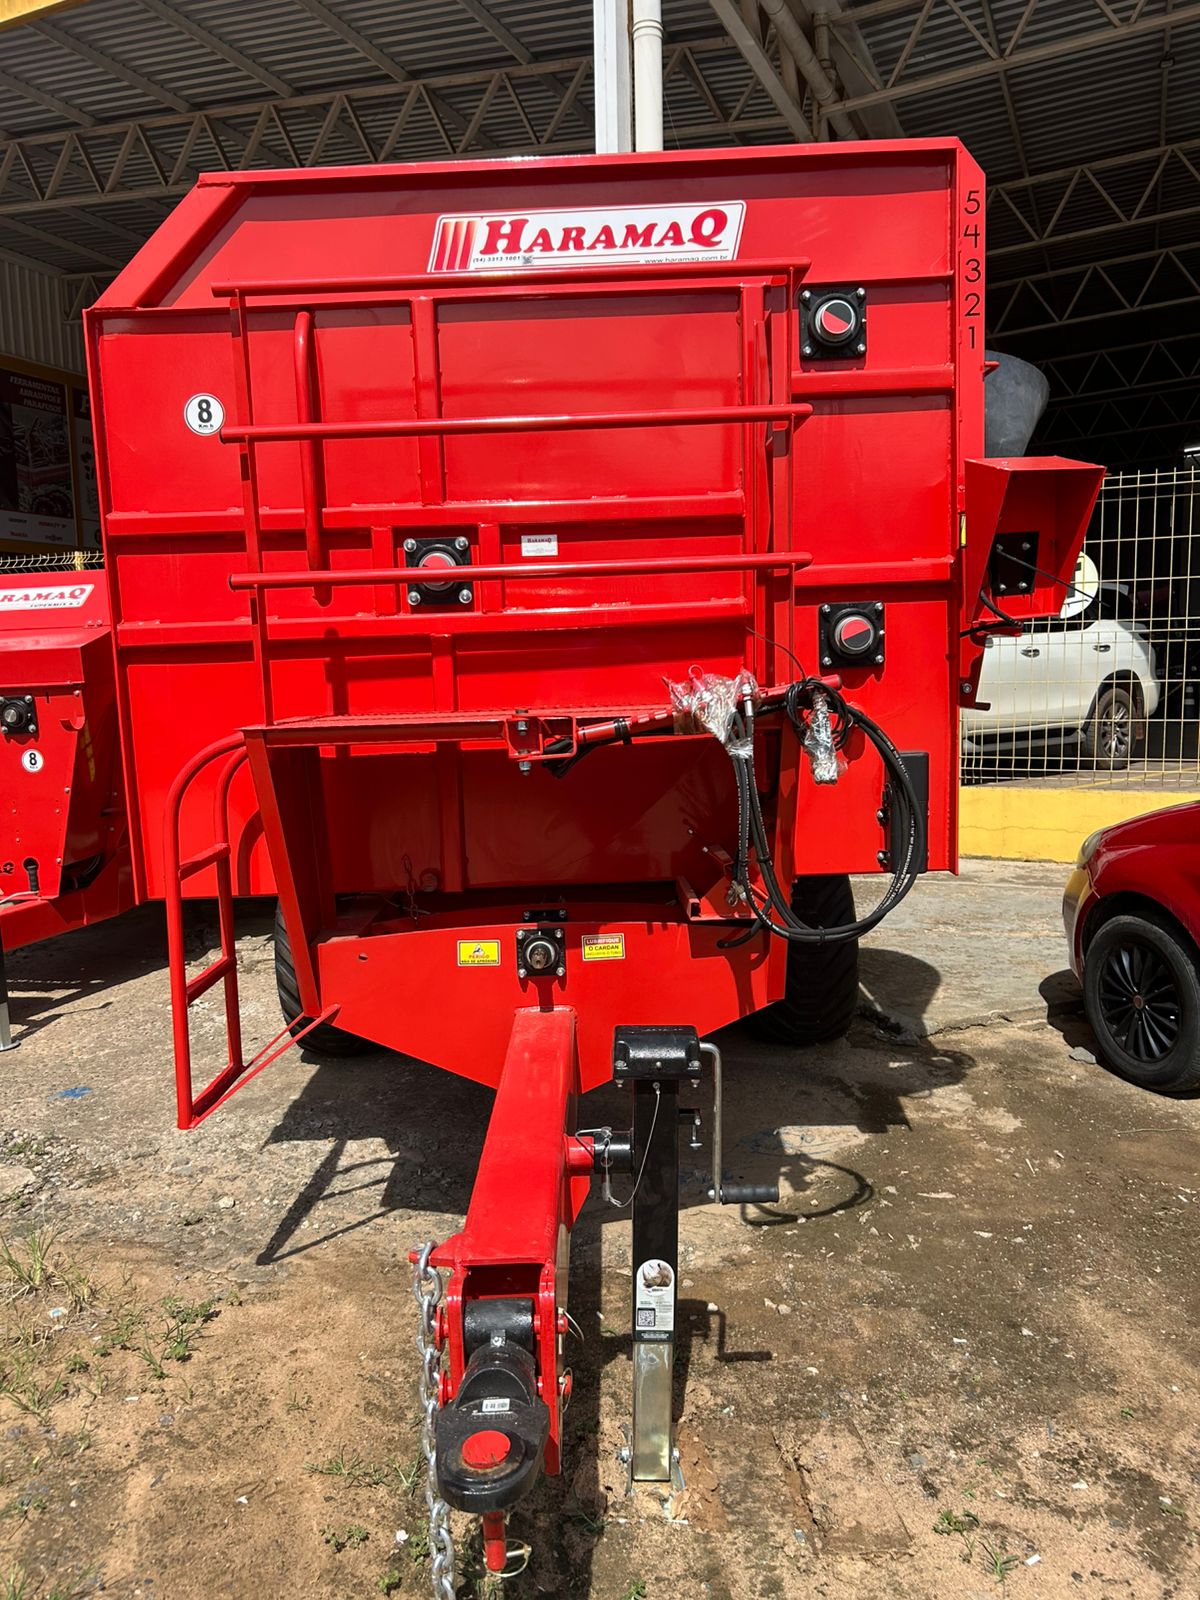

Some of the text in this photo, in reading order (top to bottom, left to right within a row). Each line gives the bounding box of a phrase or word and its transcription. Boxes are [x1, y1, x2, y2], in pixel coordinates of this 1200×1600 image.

[964, 190, 981, 215] 5
[479, 209, 729, 255] HARAMAQ
[963, 224, 981, 249] 4
[964, 258, 982, 283] 3
[964, 292, 981, 317] 2
[967, 326, 975, 349] 1
[198, 399, 212, 424] 8
[29, 752, 37, 766] 8
